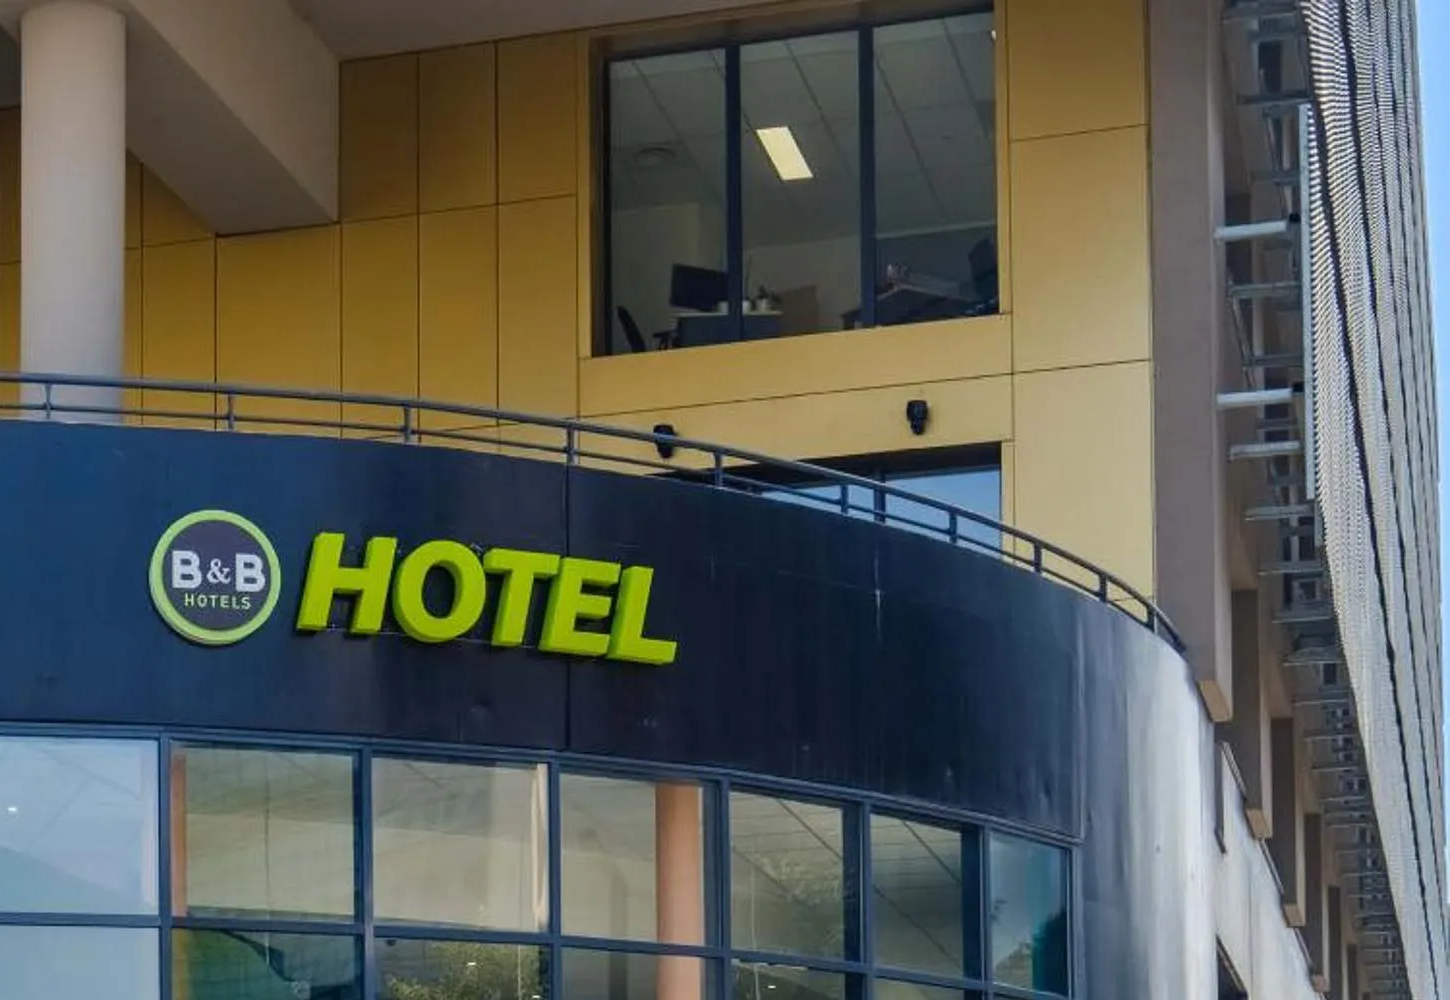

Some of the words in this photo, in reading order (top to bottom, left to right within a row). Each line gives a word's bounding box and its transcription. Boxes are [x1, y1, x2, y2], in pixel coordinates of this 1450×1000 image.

[172, 550, 266, 592] B&B
[184, 593, 252, 610] HOTELS
[297, 531, 678, 664] HOTEL
